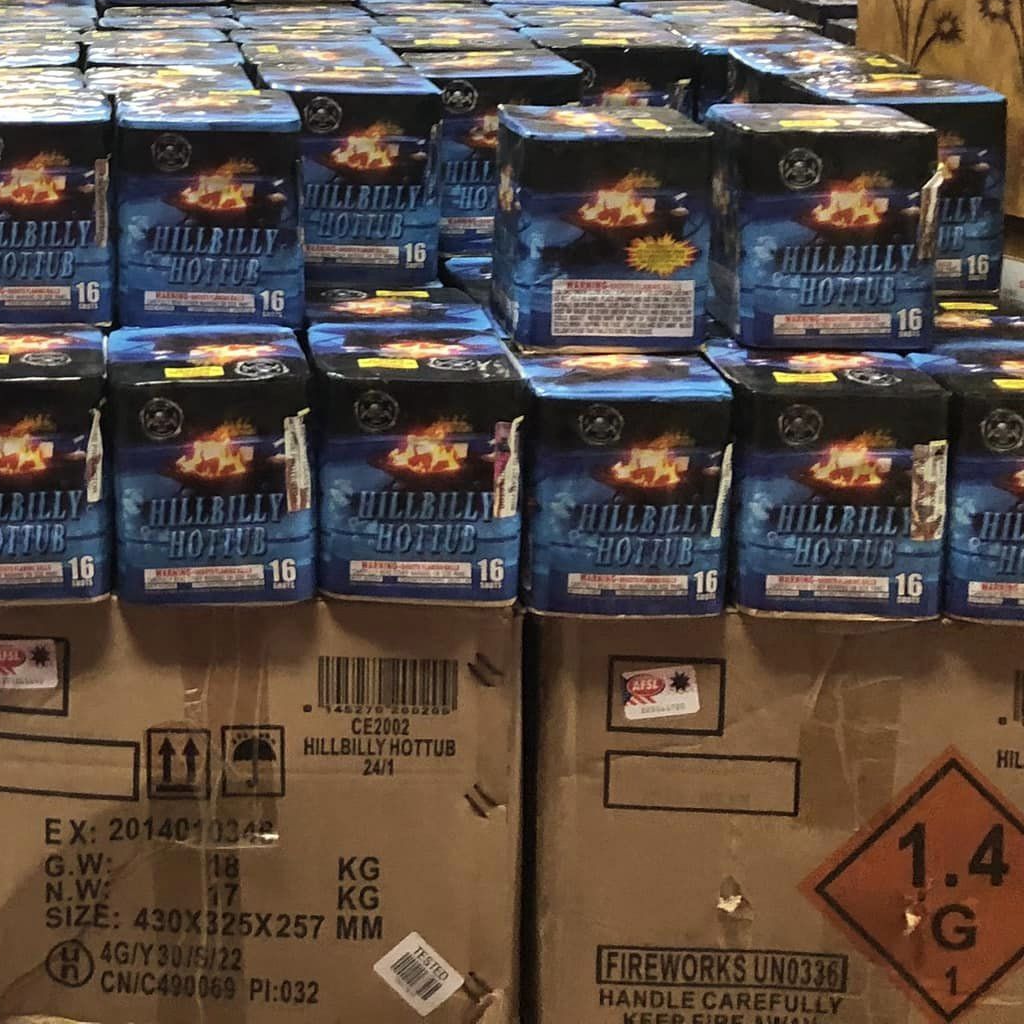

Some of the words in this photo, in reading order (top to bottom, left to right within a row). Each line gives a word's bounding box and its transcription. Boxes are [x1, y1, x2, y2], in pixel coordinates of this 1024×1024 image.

[304, 184, 426, 211] HILLBILLY
[152, 226, 281, 256] HILLBILLY
[403, 243, 427, 263] 16
[781, 244, 916, 273] HILLBILLY
[967, 255, 990, 275] 16
[76, 281, 100, 304] 16
[260, 289, 285, 313] 16
[897, 308, 923, 331] 16
[149, 494, 284, 526] HILLBILLY
[358, 491, 493, 522] HILLBILLY
[579, 504, 713, 536] HILLBILLY
[67, 556, 96, 579] 16
[269, 559, 297, 583] 16
[477, 558, 505, 581] 16
[694, 570, 718, 594] 16
[895, 573, 923, 597] 16
[351, 717, 410, 736] CE2002
[303, 738, 385, 756] HILLBILLY
[390, 739, 456, 757] HOTTUB
[362, 759, 394, 776] 24/1
[45, 853, 112, 877] G.W:
[212, 854, 239, 877] 18
[338, 857, 380, 880] KG
[899, 822, 1009, 888] 1.4
[45, 878, 111, 903] N.W:
[208, 884, 240, 906] 17
[337, 887, 380, 911] KG
[45, 905, 119, 929] SIZE:
[134, 908, 326, 940] 430X325X257
[336, 915, 383, 940] MM
[931, 903, 976, 951] G
[414, 946, 449, 981] TESTED
[606, 951, 746, 982] FIREWORKS
[754, 956, 840, 988] UN0336
[945, 966, 957, 995] 1
[599, 989, 696, 1009] HANDLE
[702, 990, 843, 1015] CAREFULLY
